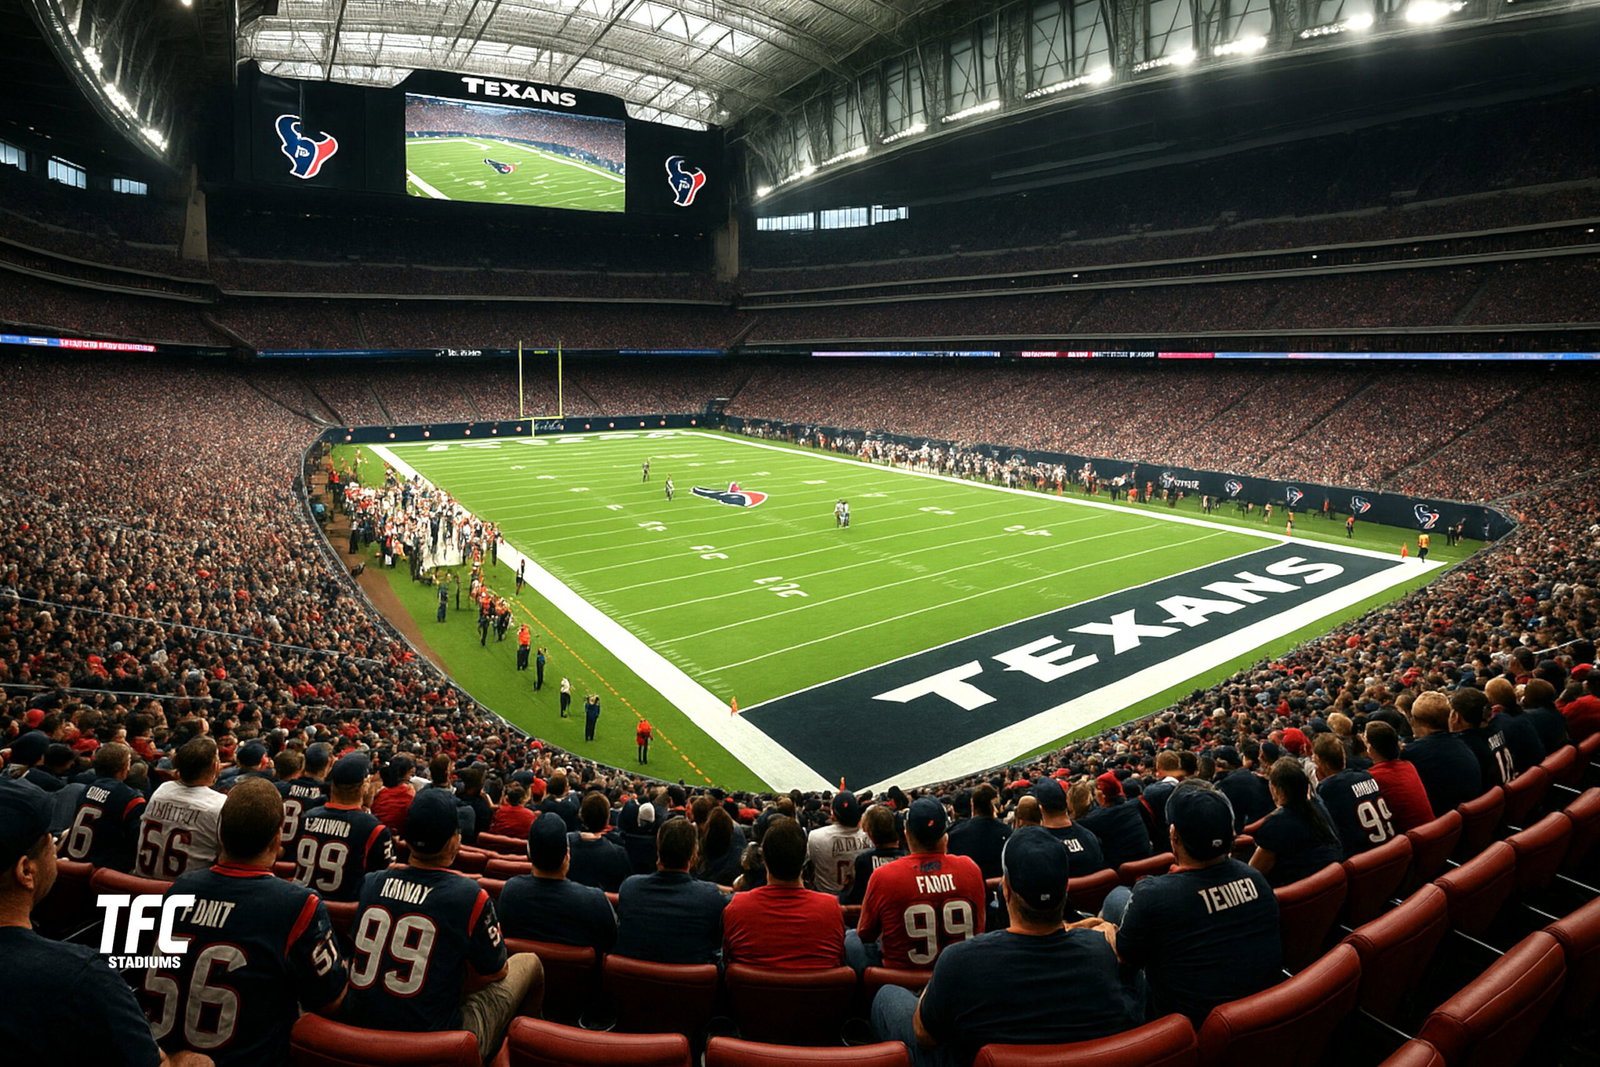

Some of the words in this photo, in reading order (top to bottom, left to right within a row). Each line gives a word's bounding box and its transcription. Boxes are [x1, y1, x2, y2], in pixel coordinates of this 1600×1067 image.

[461, 77, 577, 107] TEXANS
[872, 556, 1344, 711] TEXANS
[139, 819, 193, 877] 56
[296, 837, 349, 892] 99
[350, 906, 437, 995] 99
[904, 900, 975, 965] 99
